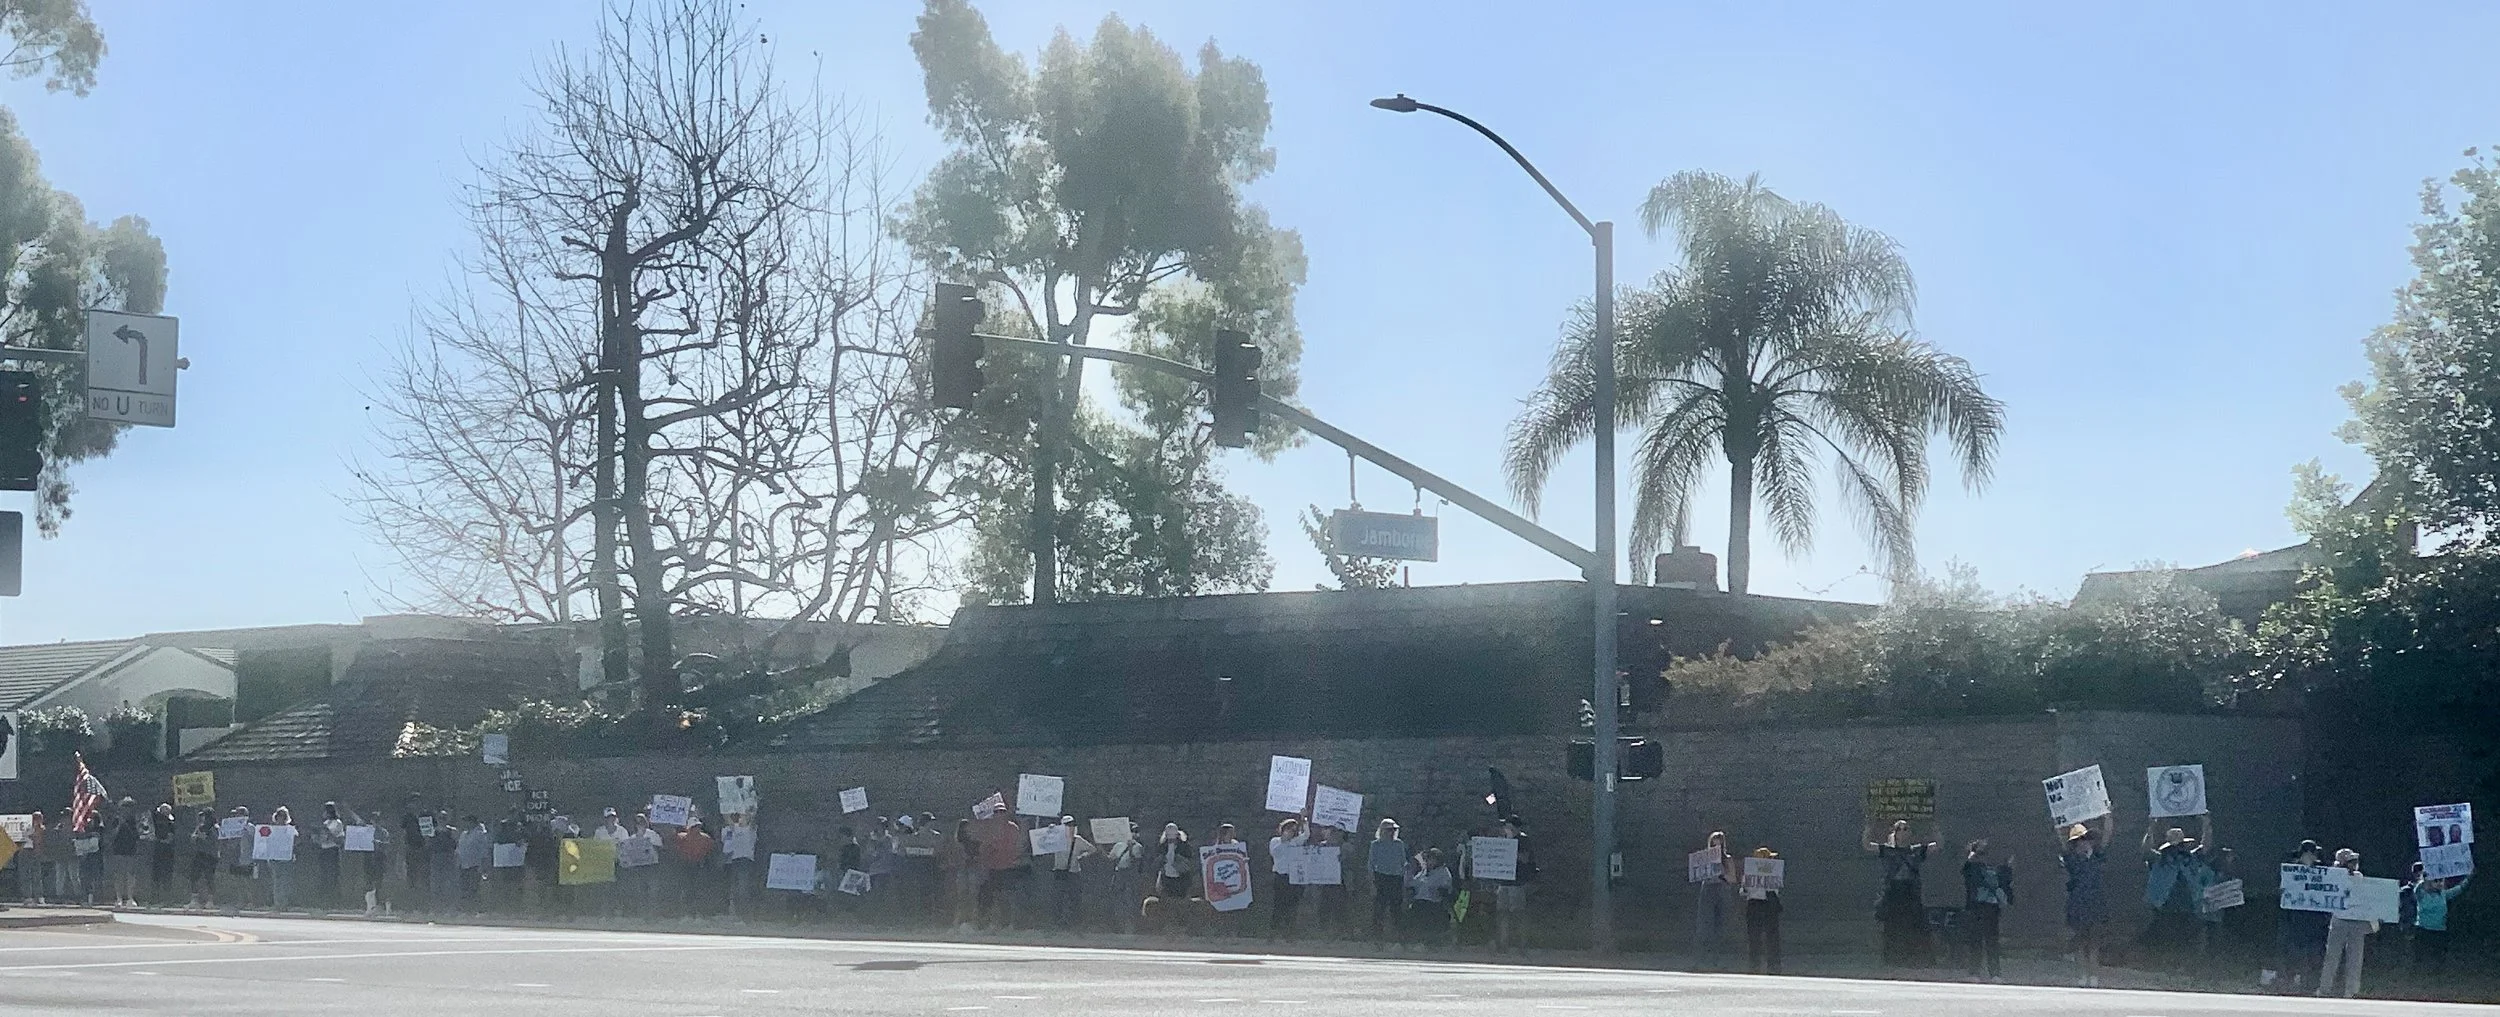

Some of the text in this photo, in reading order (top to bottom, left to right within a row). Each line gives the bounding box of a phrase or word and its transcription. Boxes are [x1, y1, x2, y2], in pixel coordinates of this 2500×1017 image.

[92, 396, 168, 416] NO U TURN
